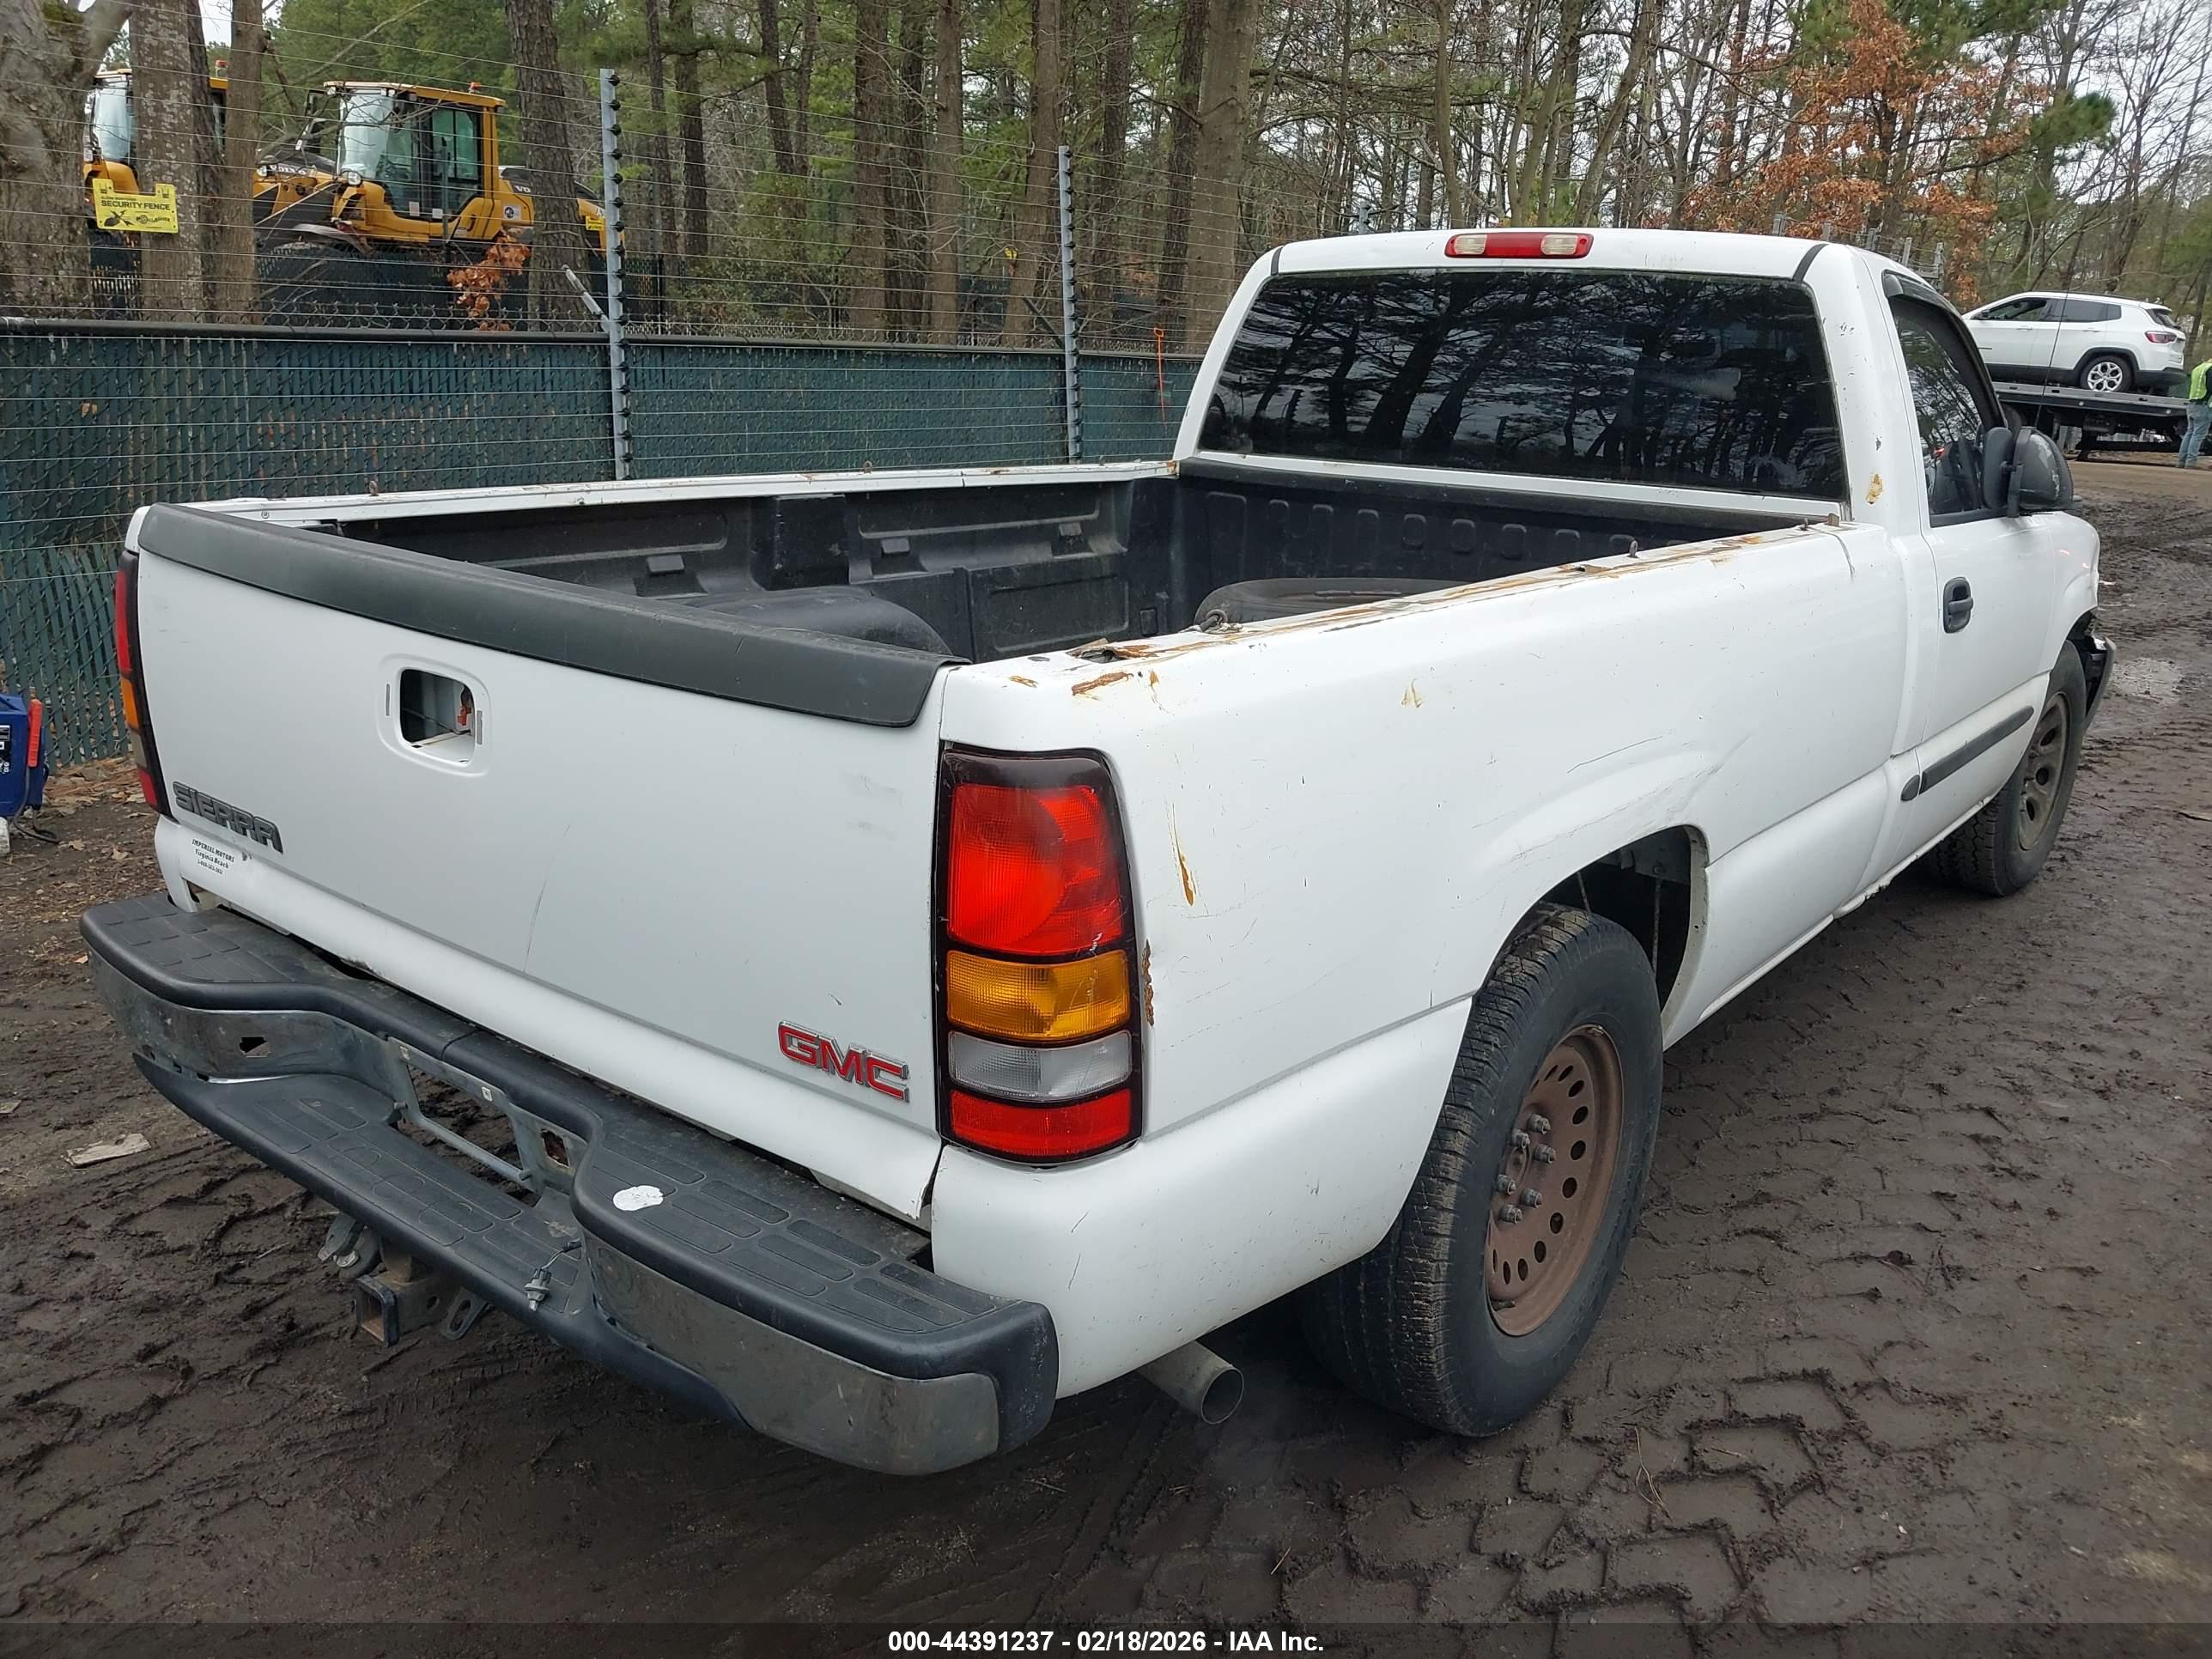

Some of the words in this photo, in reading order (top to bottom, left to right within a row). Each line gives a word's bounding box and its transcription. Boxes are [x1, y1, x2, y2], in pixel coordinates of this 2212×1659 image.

[100, 200, 143, 210] SECURITY
[143, 202, 171, 211] FENCE
[173, 781, 283, 854] SIERRA
[191, 838, 215, 854] IMPERIAL
[216, 849, 235, 863] MOTORS
[195, 848, 214, 862] Virginia
[214, 858, 229, 869] Beach
[778, 1021, 910, 1103] GMC
